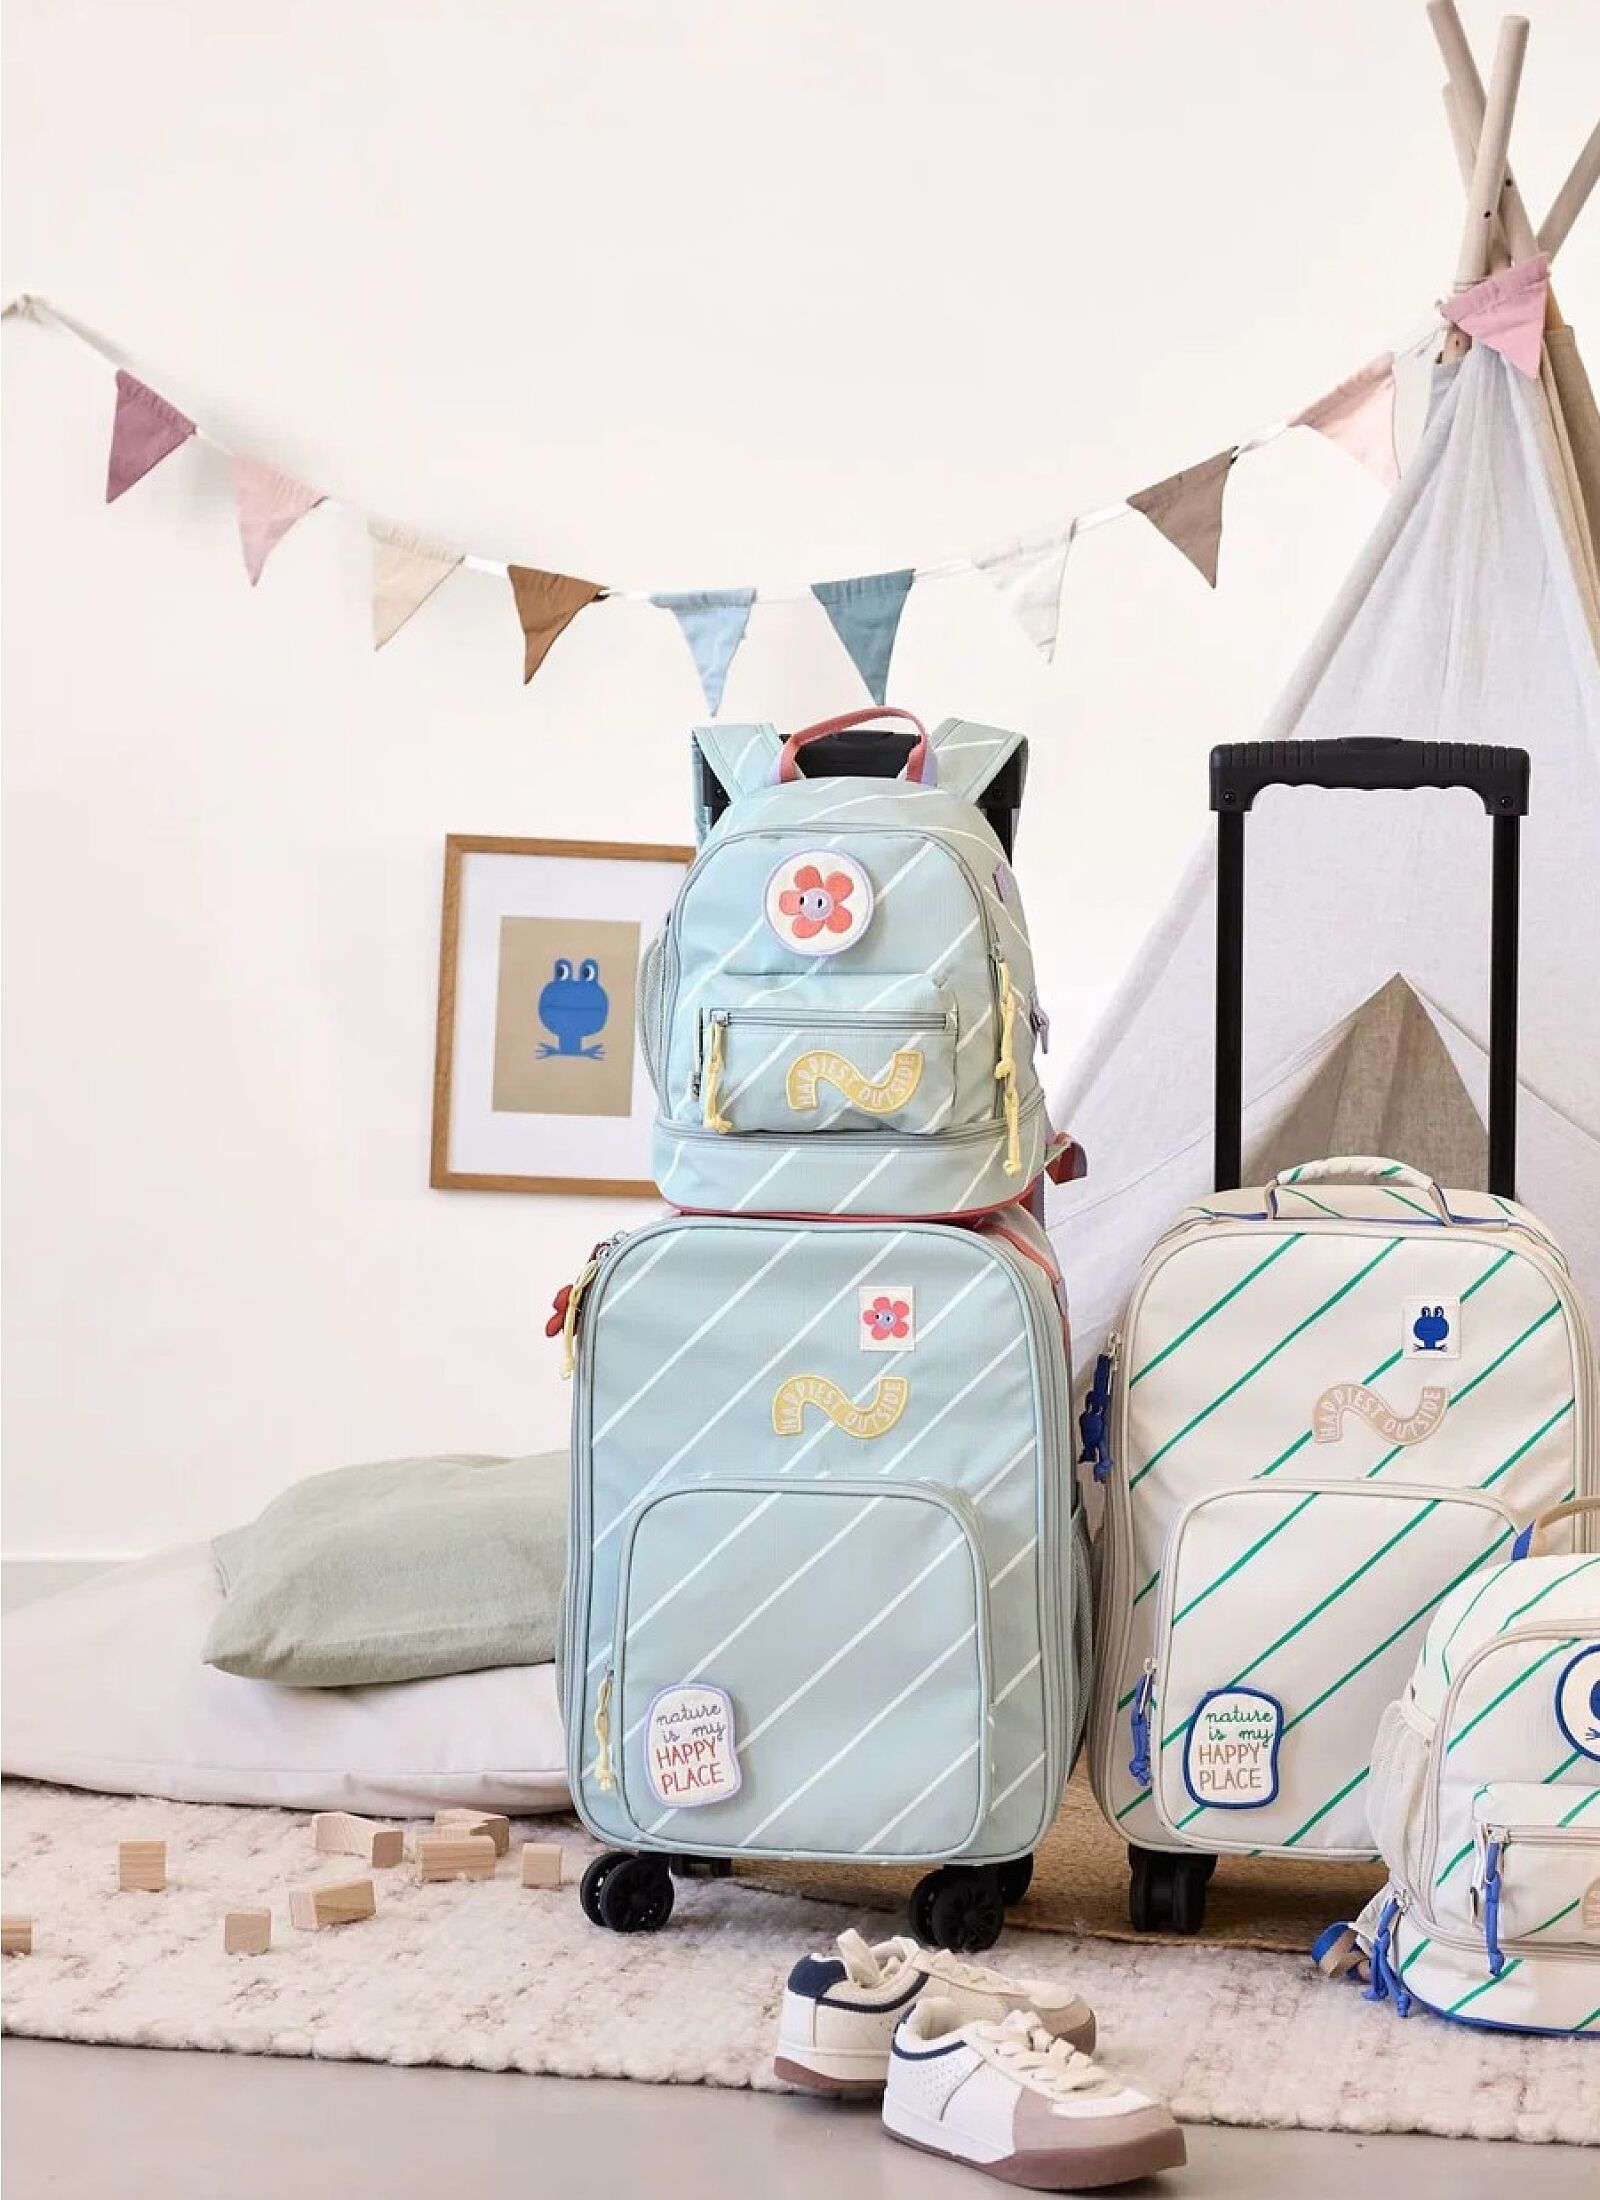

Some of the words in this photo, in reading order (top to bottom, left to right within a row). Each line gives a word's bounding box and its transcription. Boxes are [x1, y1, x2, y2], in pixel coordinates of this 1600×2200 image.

[780, 1381, 842, 1433] HAPPIEST
[844, 1382, 902, 1432] OUTSIDE
[1319, 1387, 1387, 1438] HAPPIEST
[1383, 1389, 1439, 1441] OUTSIDE
[656, 1703, 721, 1726] nature
[1205, 1705, 1273, 1723] nature
[662, 1728, 681, 1744] is
[691, 1722, 726, 1742] my
[1208, 1726, 1227, 1741] is
[1238, 1728, 1274, 1748] my
[656, 1736, 716, 1769] HAPPY
[1200, 1742, 1260, 1765] HAPPY
[661, 1762, 725, 1794] PLACE
[1200, 1767, 1262, 1791] PLACE
